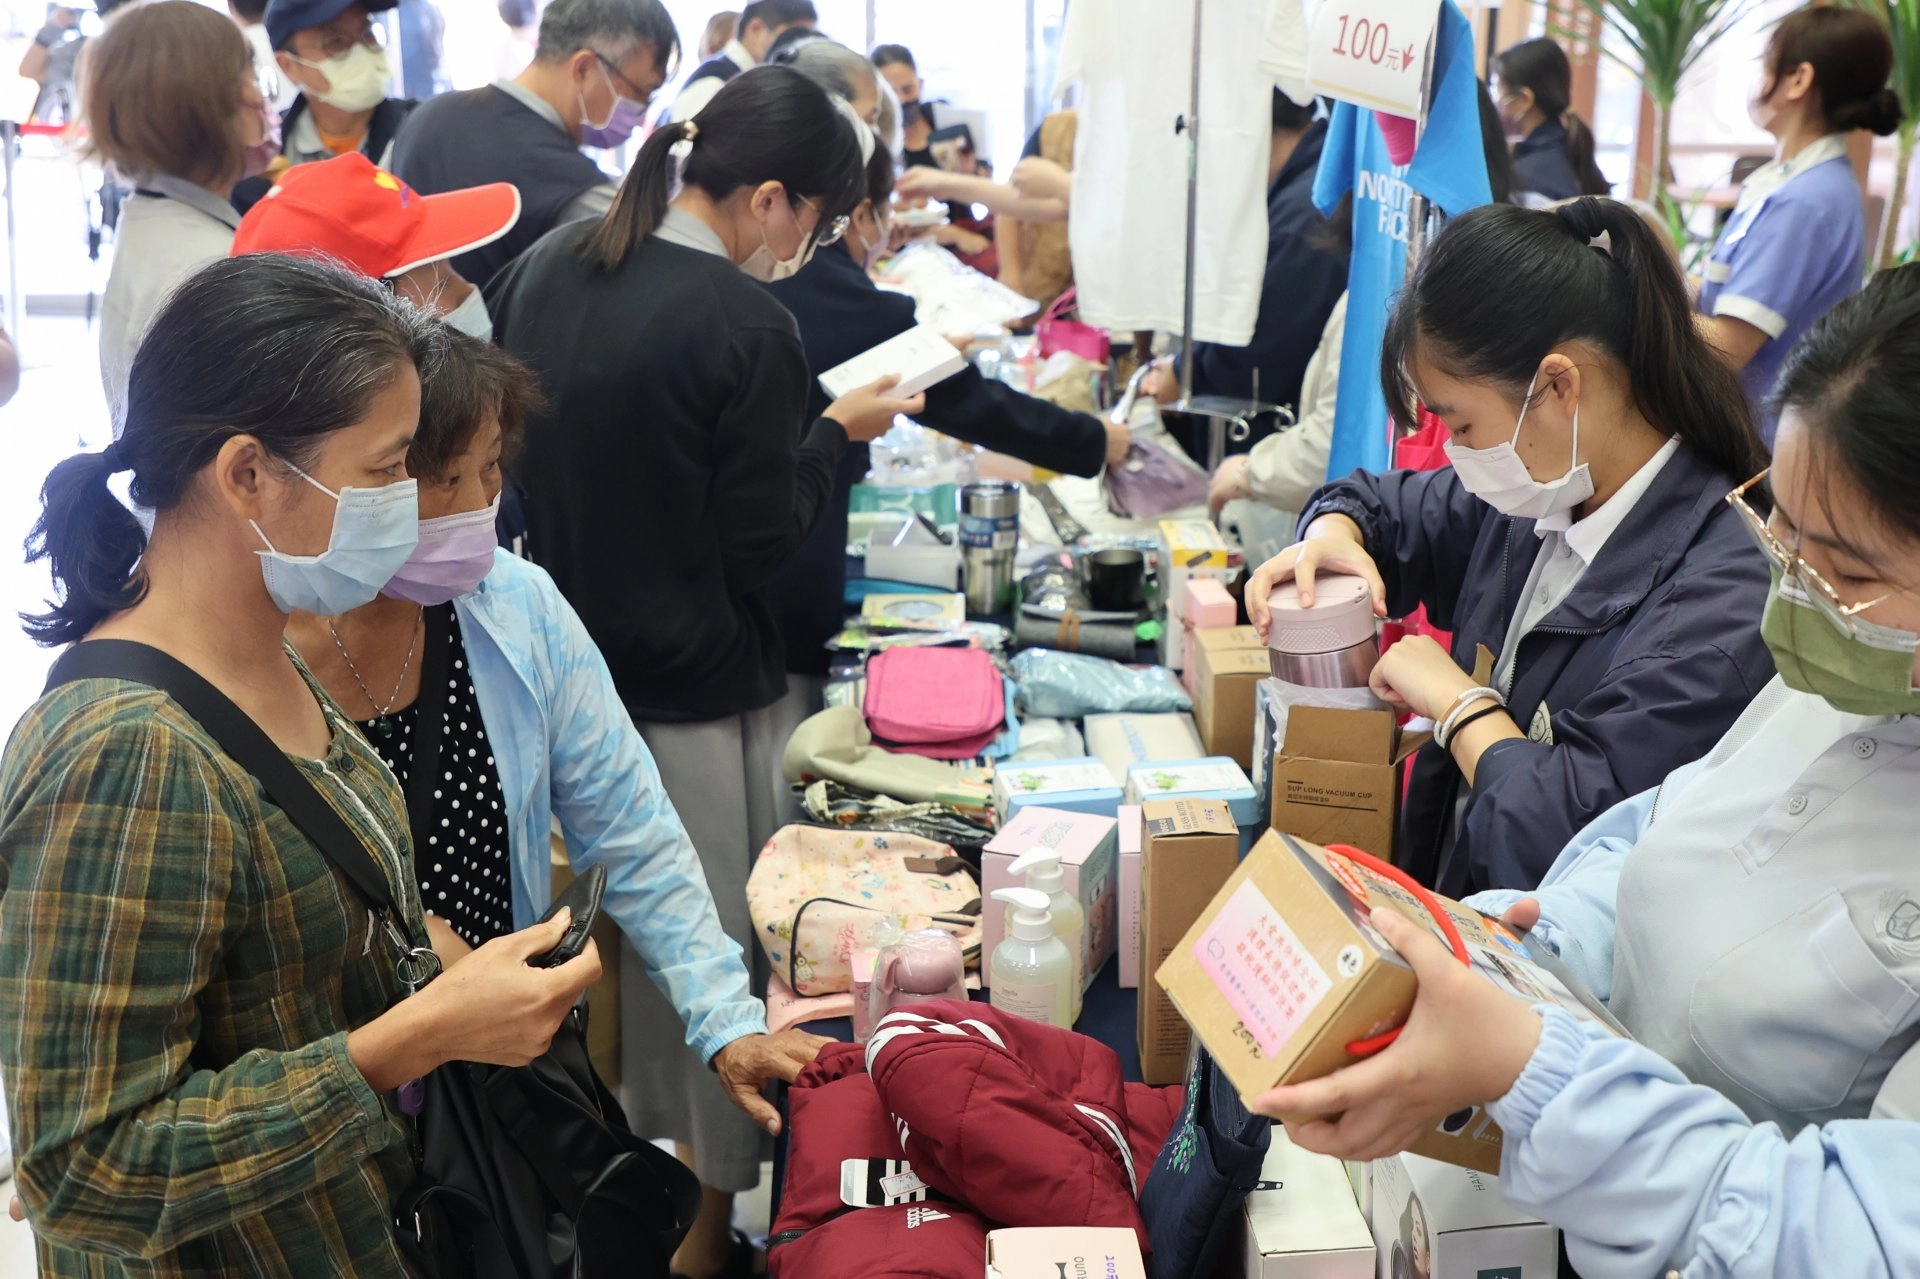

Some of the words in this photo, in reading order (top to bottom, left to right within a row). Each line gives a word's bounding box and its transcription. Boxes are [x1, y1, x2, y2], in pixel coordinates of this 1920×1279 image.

[1332, 14, 1401, 72] 100元
[1303, 786, 1323, 794] LONG
[1325, 789, 1355, 797] VACUUM
